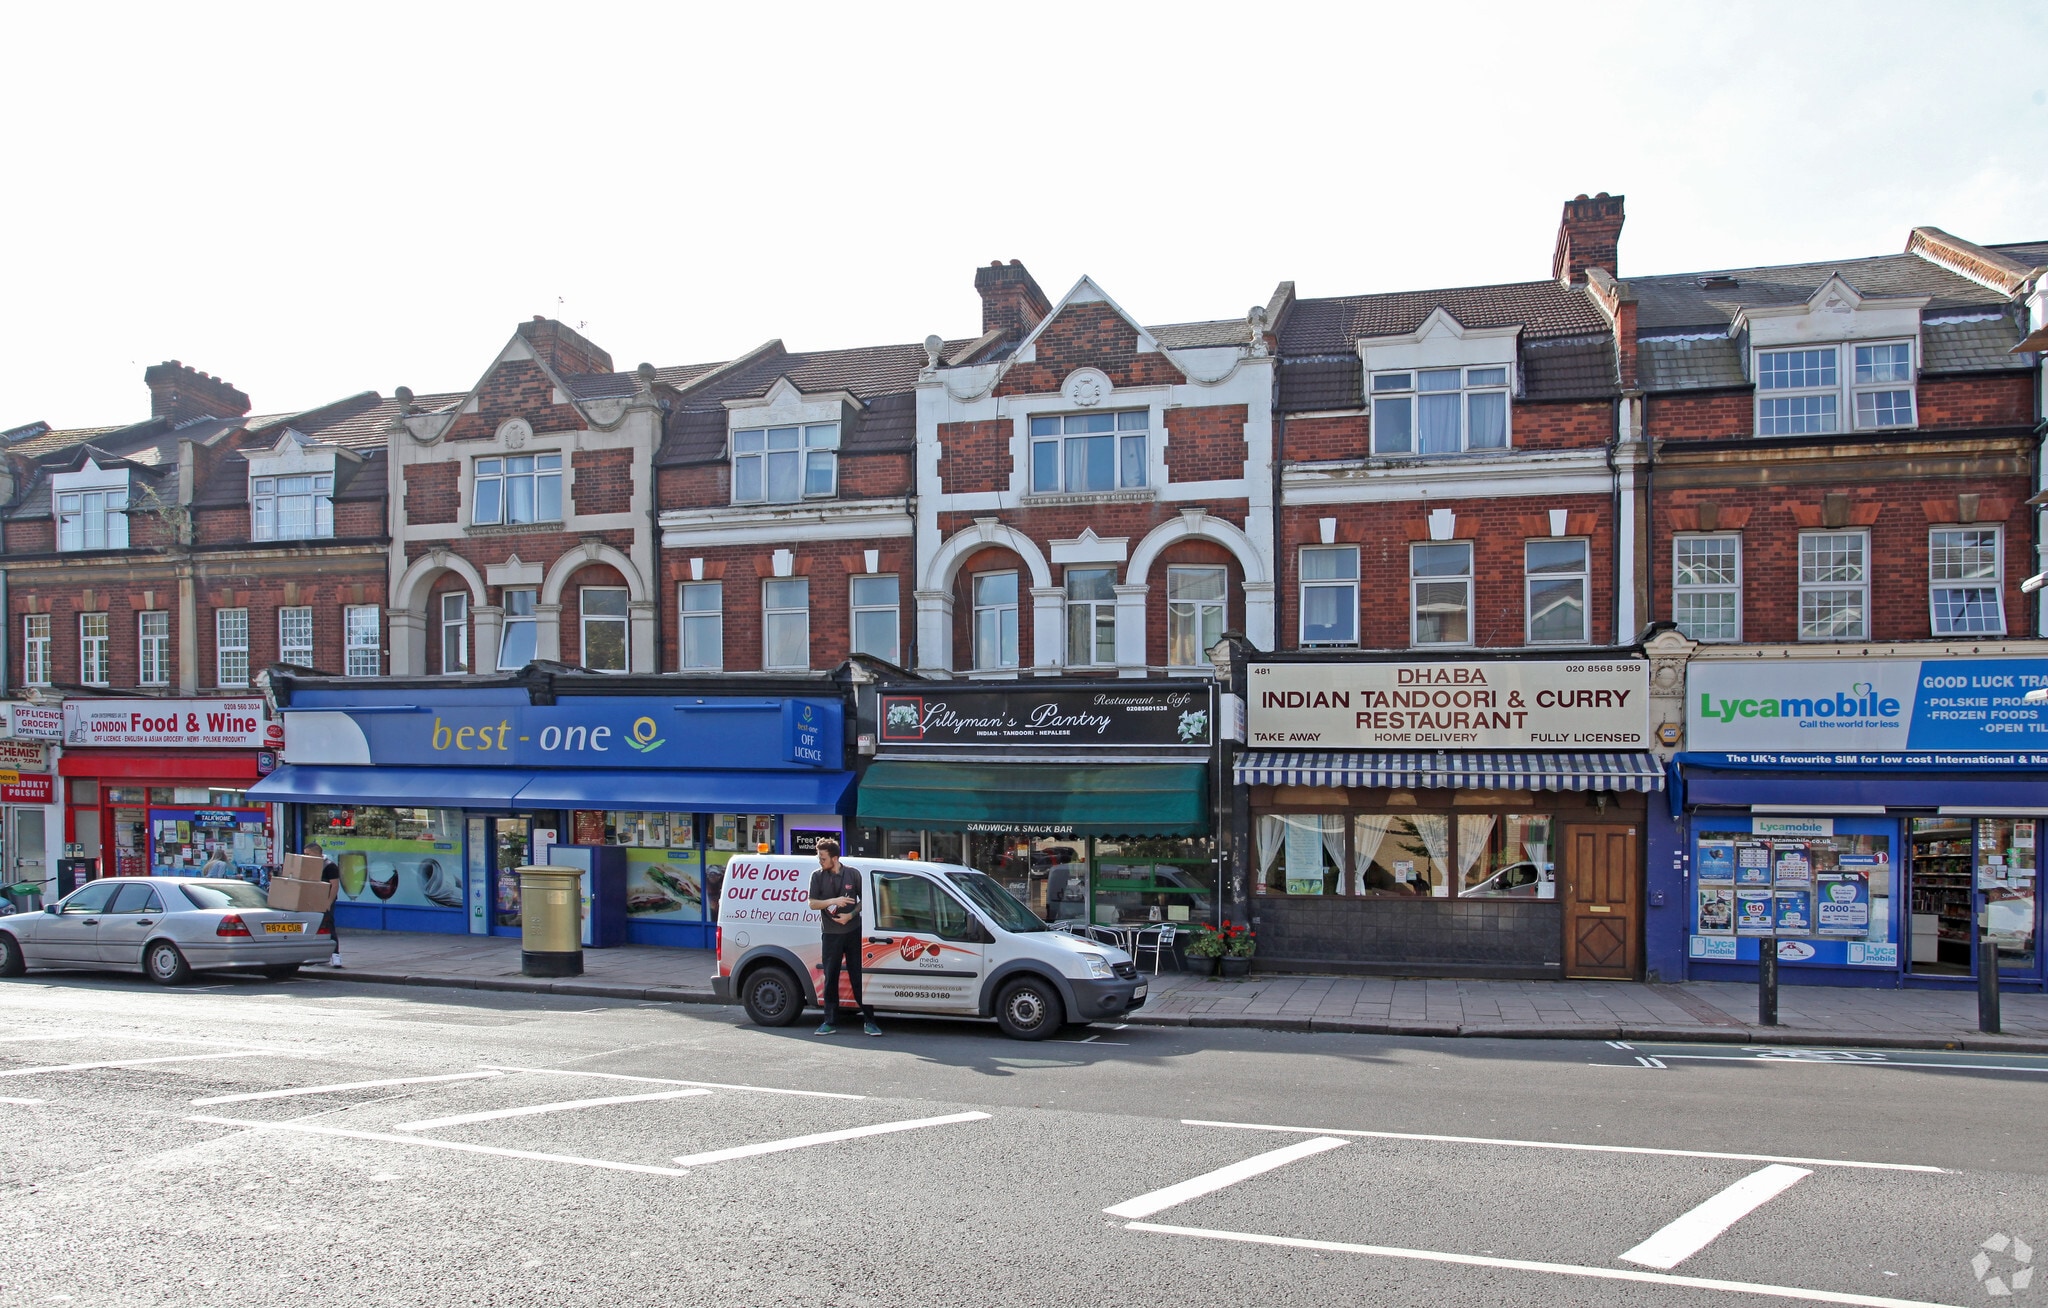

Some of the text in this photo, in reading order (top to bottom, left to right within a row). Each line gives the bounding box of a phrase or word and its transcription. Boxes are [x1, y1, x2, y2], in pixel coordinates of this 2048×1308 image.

[1397, 668, 1487, 684] DHABA
[1923, 676, 1968, 688] GOOD
[1972, 675, 2014, 688] LUCK
[1093, 694, 1154, 706] Restaurant
[1166, 692, 1191, 707] Cafe
[1262, 690, 1631, 708] INDIAN TANDOORI & CURRY
[1930, 697, 1988, 707] POLSKIE
[1701, 692, 1900, 723] Lycamobile
[16, 709, 64, 720] OFF LICENCE
[912, 702, 1111, 734] Lillyman's Pantry
[1932, 710, 2039, 720] FROZEN FOODS
[22, 719, 59, 729] GROCERY
[91, 713, 257, 733] LONDON Food & Wine
[1356, 712, 1528, 729] RESTAURANT
[1799, 720, 1900, 728] Call the world for less
[432, 717, 512, 751] best
[539, 725, 612, 751] one
[1985, 724, 2023, 733] OPEN
[801, 734, 815, 746] OFF
[1254, 733, 1321, 742] TAKE AWAY
[1374, 733, 1478, 742] HOME DELIVERY
[1530, 733, 1641, 742] FULLY LICENSED
[794, 746, 822, 761] LICENCE
[1726, 754, 2048, 764] The UK's favourite SIM for low cost International & Na
[3, 780, 50, 789] DUKTY
[9, 789, 45, 797] POLSKIE
[967, 823, 1012, 832] SANDWICH
[1022, 825, 1052, 833] SNACK
[1054, 825, 1073, 833] BAR
[1760, 822, 1823, 832] Lycamobile
[796, 836, 813, 844] Free
[731, 863, 800, 882] We love
[728, 887, 758, 900] our
[1823, 905, 1849, 913] 2000
[726, 908, 822, 924] ...so they can lov
[266, 924, 286, 932] R874
[901, 939, 923, 958] Virgin
[1707, 938, 1735, 949] Lyca
[1866, 945, 1896, 956] Lyca
[915, 991, 930, 999] 953
